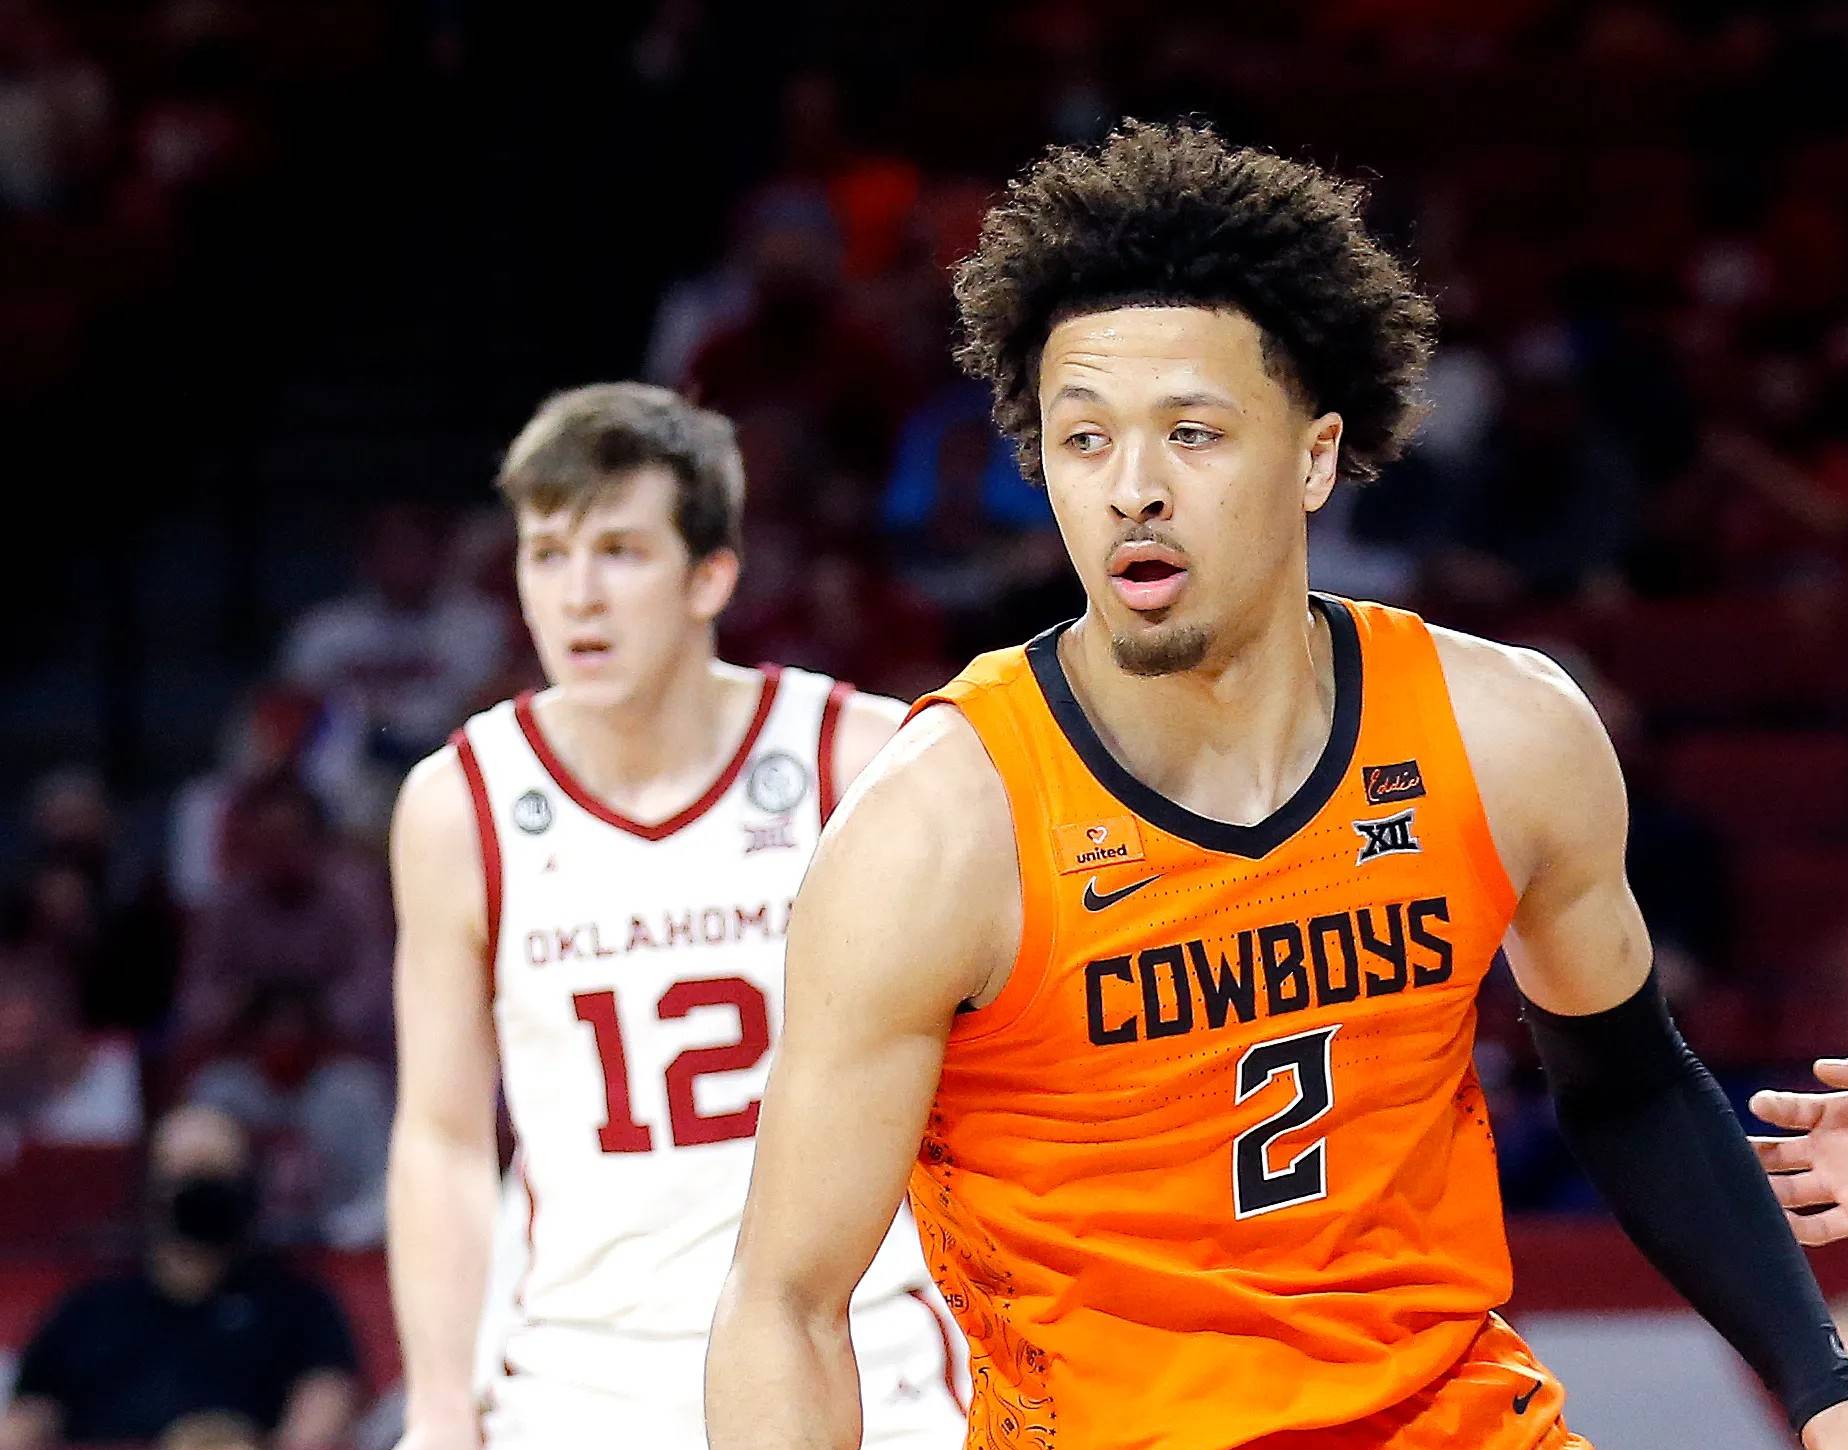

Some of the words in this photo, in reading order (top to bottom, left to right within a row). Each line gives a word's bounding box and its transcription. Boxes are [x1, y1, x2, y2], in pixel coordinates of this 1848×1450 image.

[1076, 843, 1127, 864] united
[1352, 808, 1423, 866] XII
[1085, 897, 1452, 1046] COWBOYS
[573, 977, 771, 1152] 12
[1234, 1024, 1343, 1221] 2
